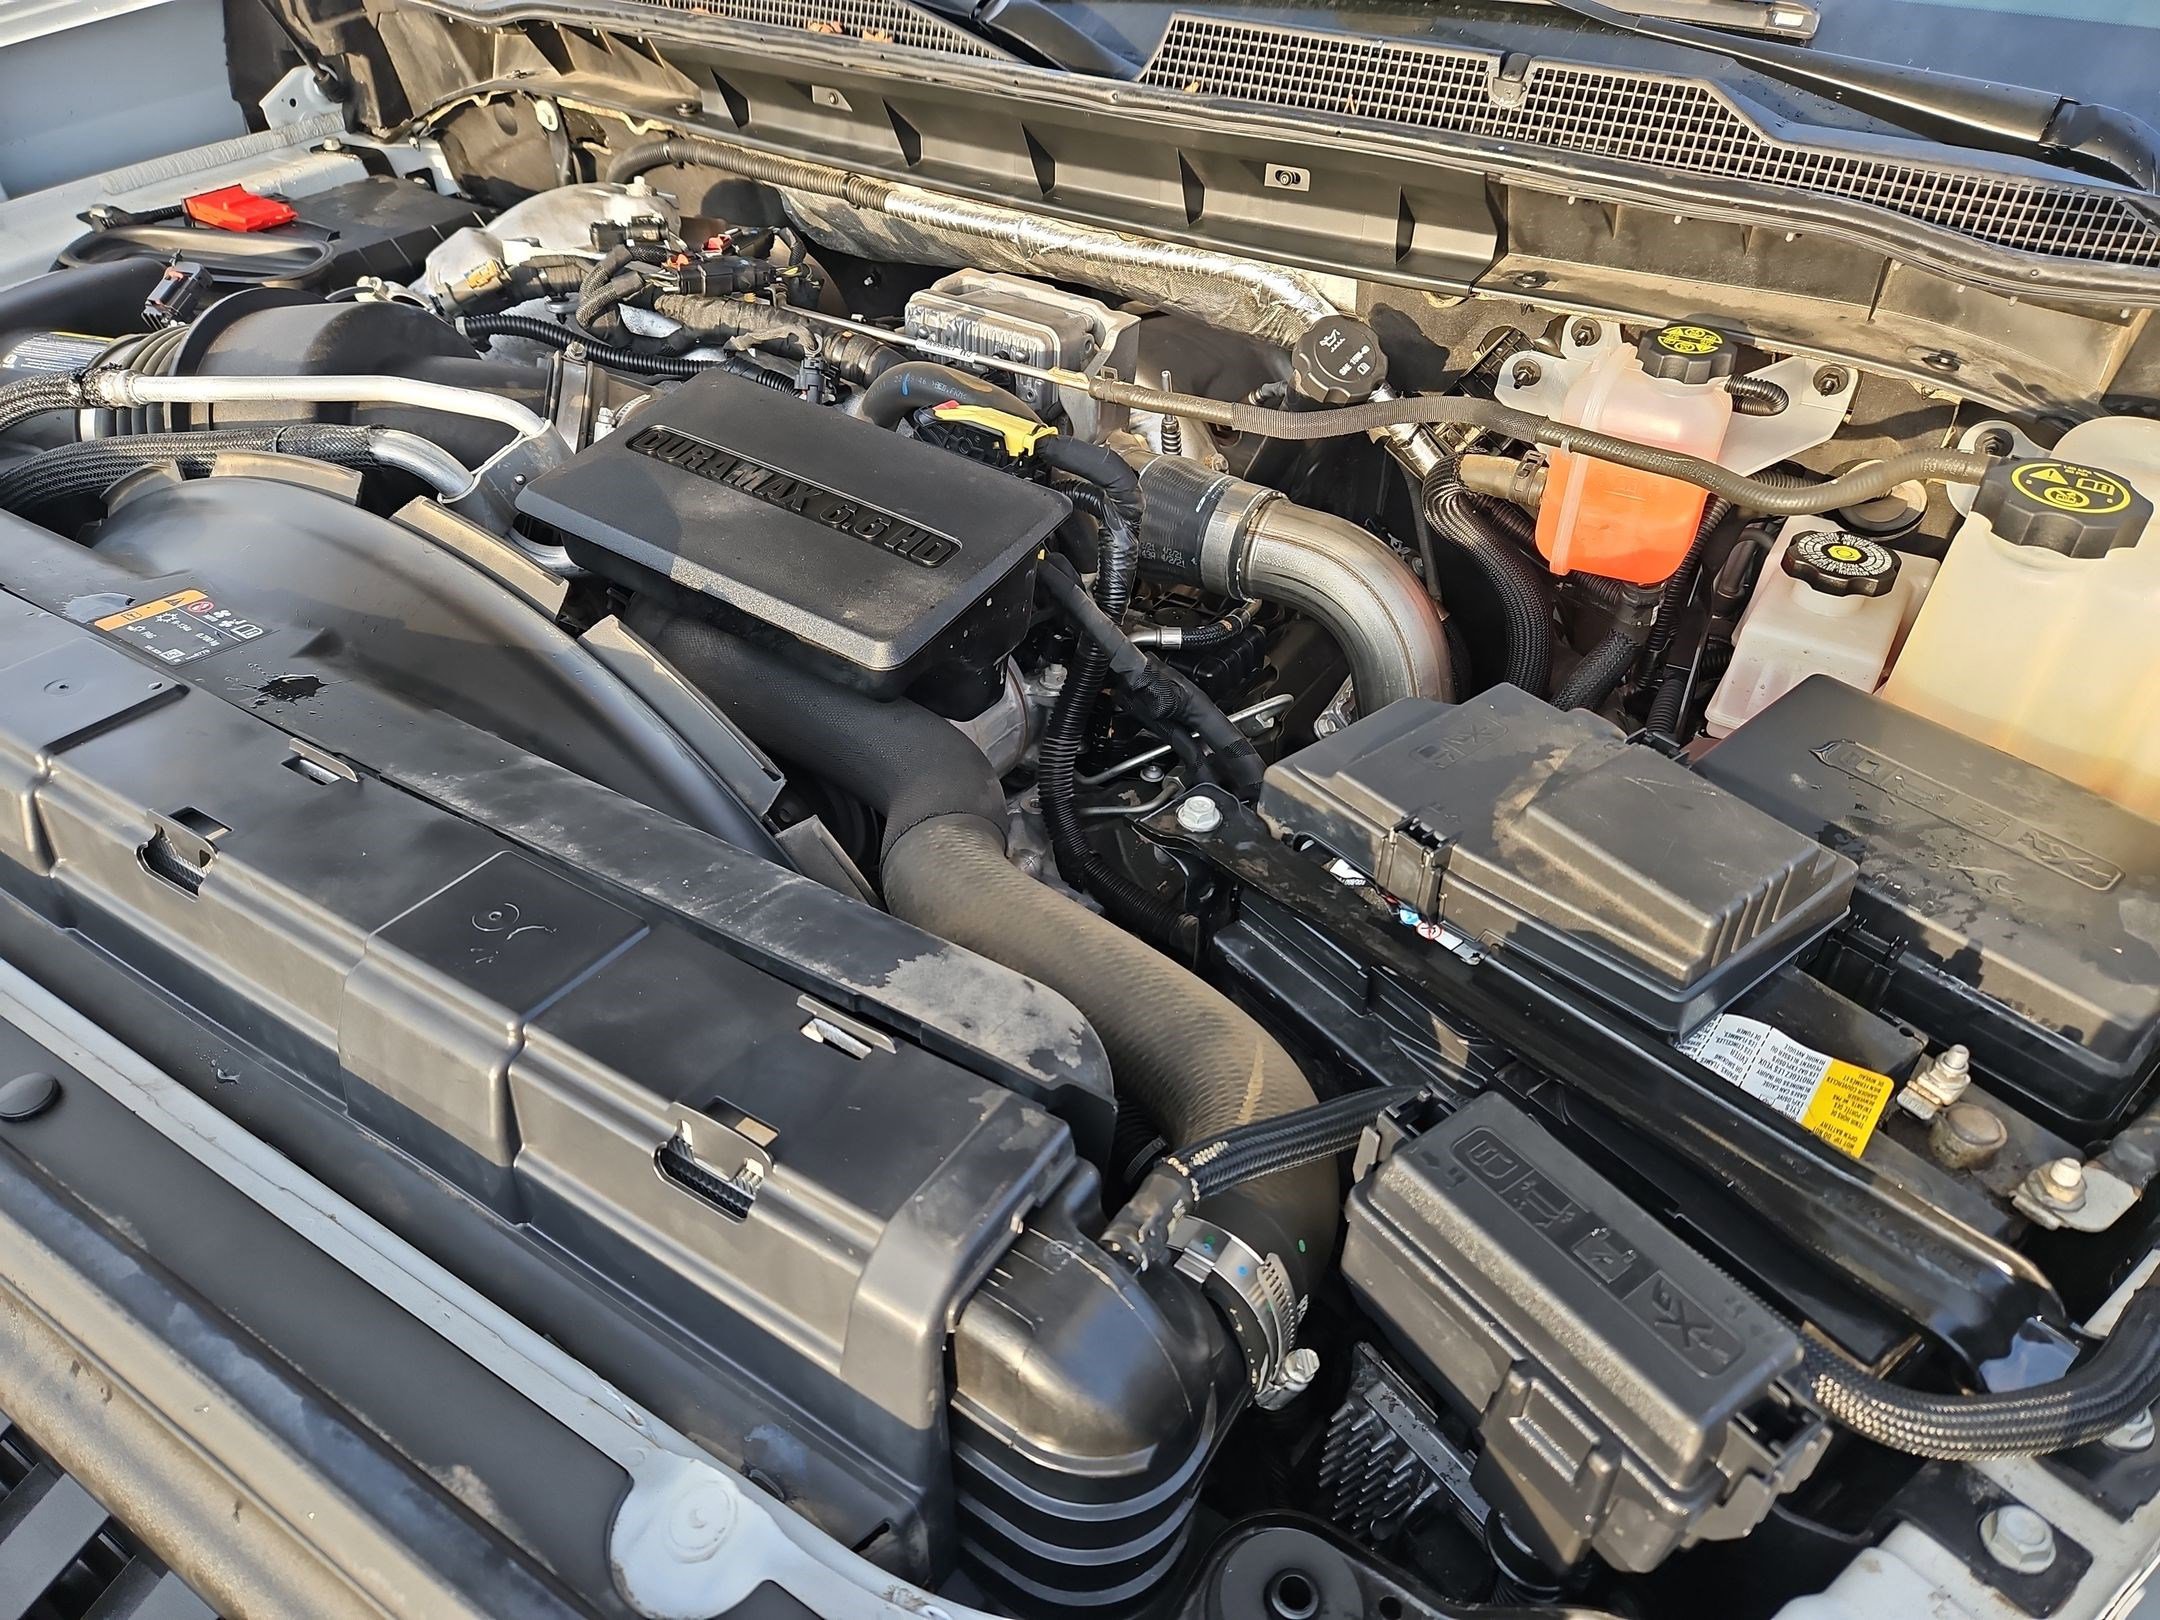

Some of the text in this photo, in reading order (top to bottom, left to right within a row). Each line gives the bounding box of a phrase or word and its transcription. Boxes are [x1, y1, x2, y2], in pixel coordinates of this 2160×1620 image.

[1339, 362, 1353, 376] SAE
[632, 432, 953, 565] DURAMAX 6.6 HD
[1735, 1027, 1754, 1037] FUMER
[1747, 1039, 1757, 1048] LES
[1729, 1047, 1748, 1065] ÉVITER
[1743, 1046, 1753, 1056] LES
[1769, 1044, 1822, 1072] PEUVENT BLESSER OU
[1783, 1043, 1825, 1066] RENDRE AVEUGLE
[1713, 1053, 1743, 1073] OR SMOKING
[1757, 1057, 1773, 1070] YEUX
[1771, 1055, 1798, 1072] EXPLOSIFS
[1773, 1064, 1785, 1075] LES
[1797, 1067, 1808, 1076] GAZ
[1755, 1068, 1811, 1093] BLINDNESS OR INJURY
[1762, 1079, 1807, 1100] GASES CAN CAUSE
[1776, 1093, 1803, 1107] EXPLOSIVE
[1784, 1103, 1800, 1115] EYES
[1819, 1120, 1842, 1135] BATTERY
